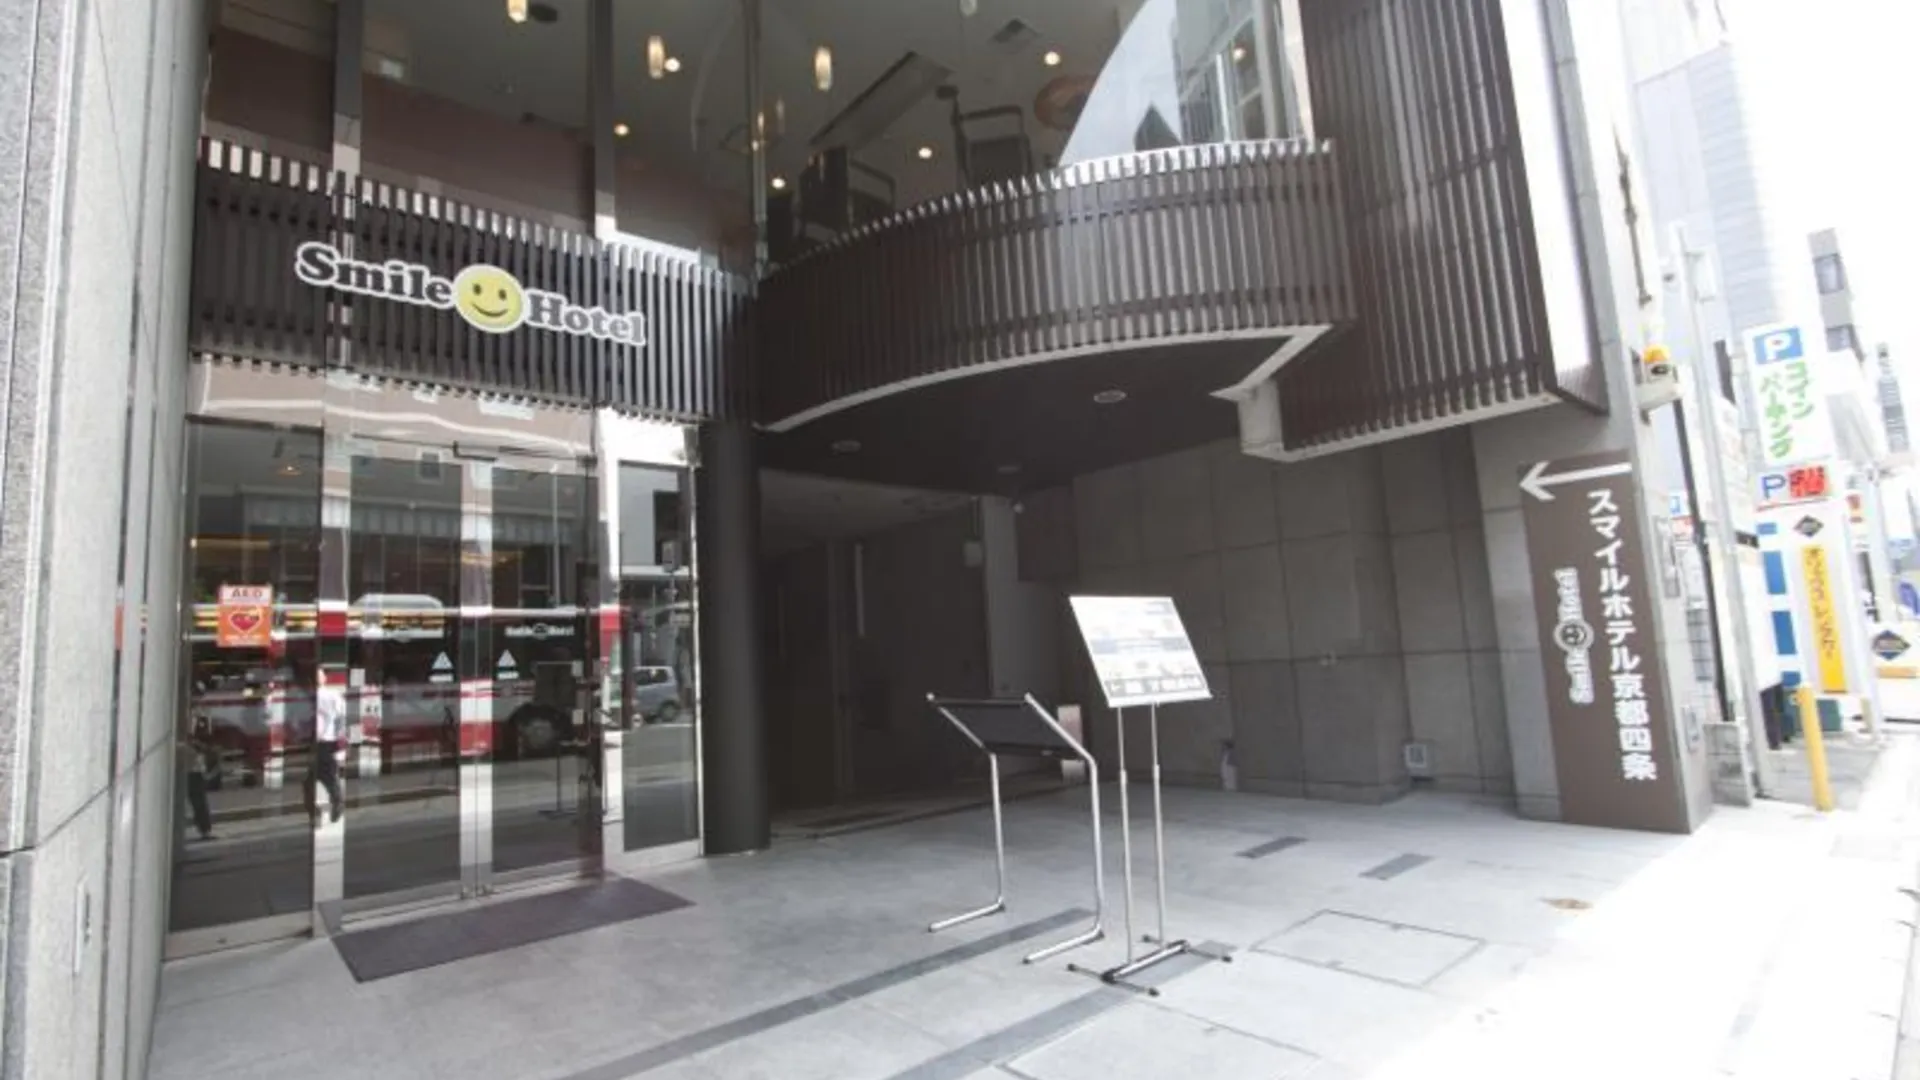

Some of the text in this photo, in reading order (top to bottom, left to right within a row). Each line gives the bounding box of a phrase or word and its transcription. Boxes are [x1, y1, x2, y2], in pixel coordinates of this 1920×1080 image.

[296, 242, 645, 345] Smile Hotel
[1785, 361, 1815, 420] コイン
[1587, 488, 1657, 781] スマイルホテル京都四条
